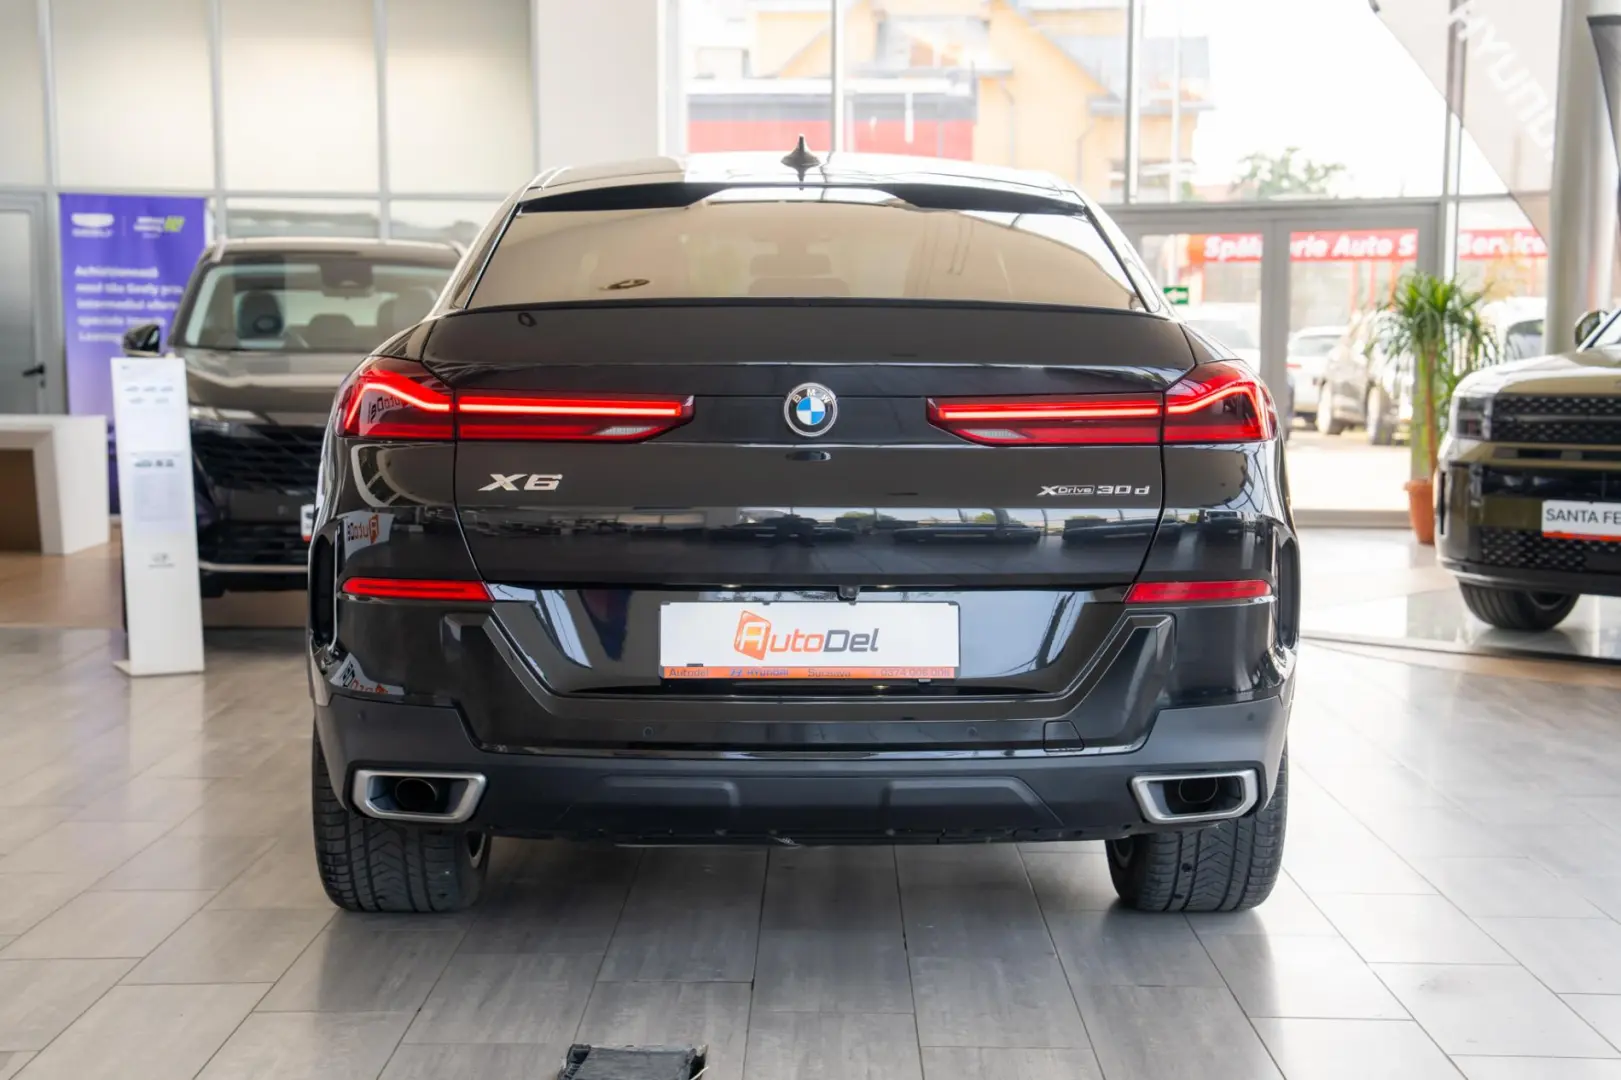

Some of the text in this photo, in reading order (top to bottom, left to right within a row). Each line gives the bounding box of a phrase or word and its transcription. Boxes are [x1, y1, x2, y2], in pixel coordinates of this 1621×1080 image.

[1332, 235, 1393, 257] Auto
[791, 388, 832, 404] BMW
[477, 473, 564, 492] X6
[1545, 507, 1621, 526] SANTA FE
[733, 610, 879, 661] AutoDel
